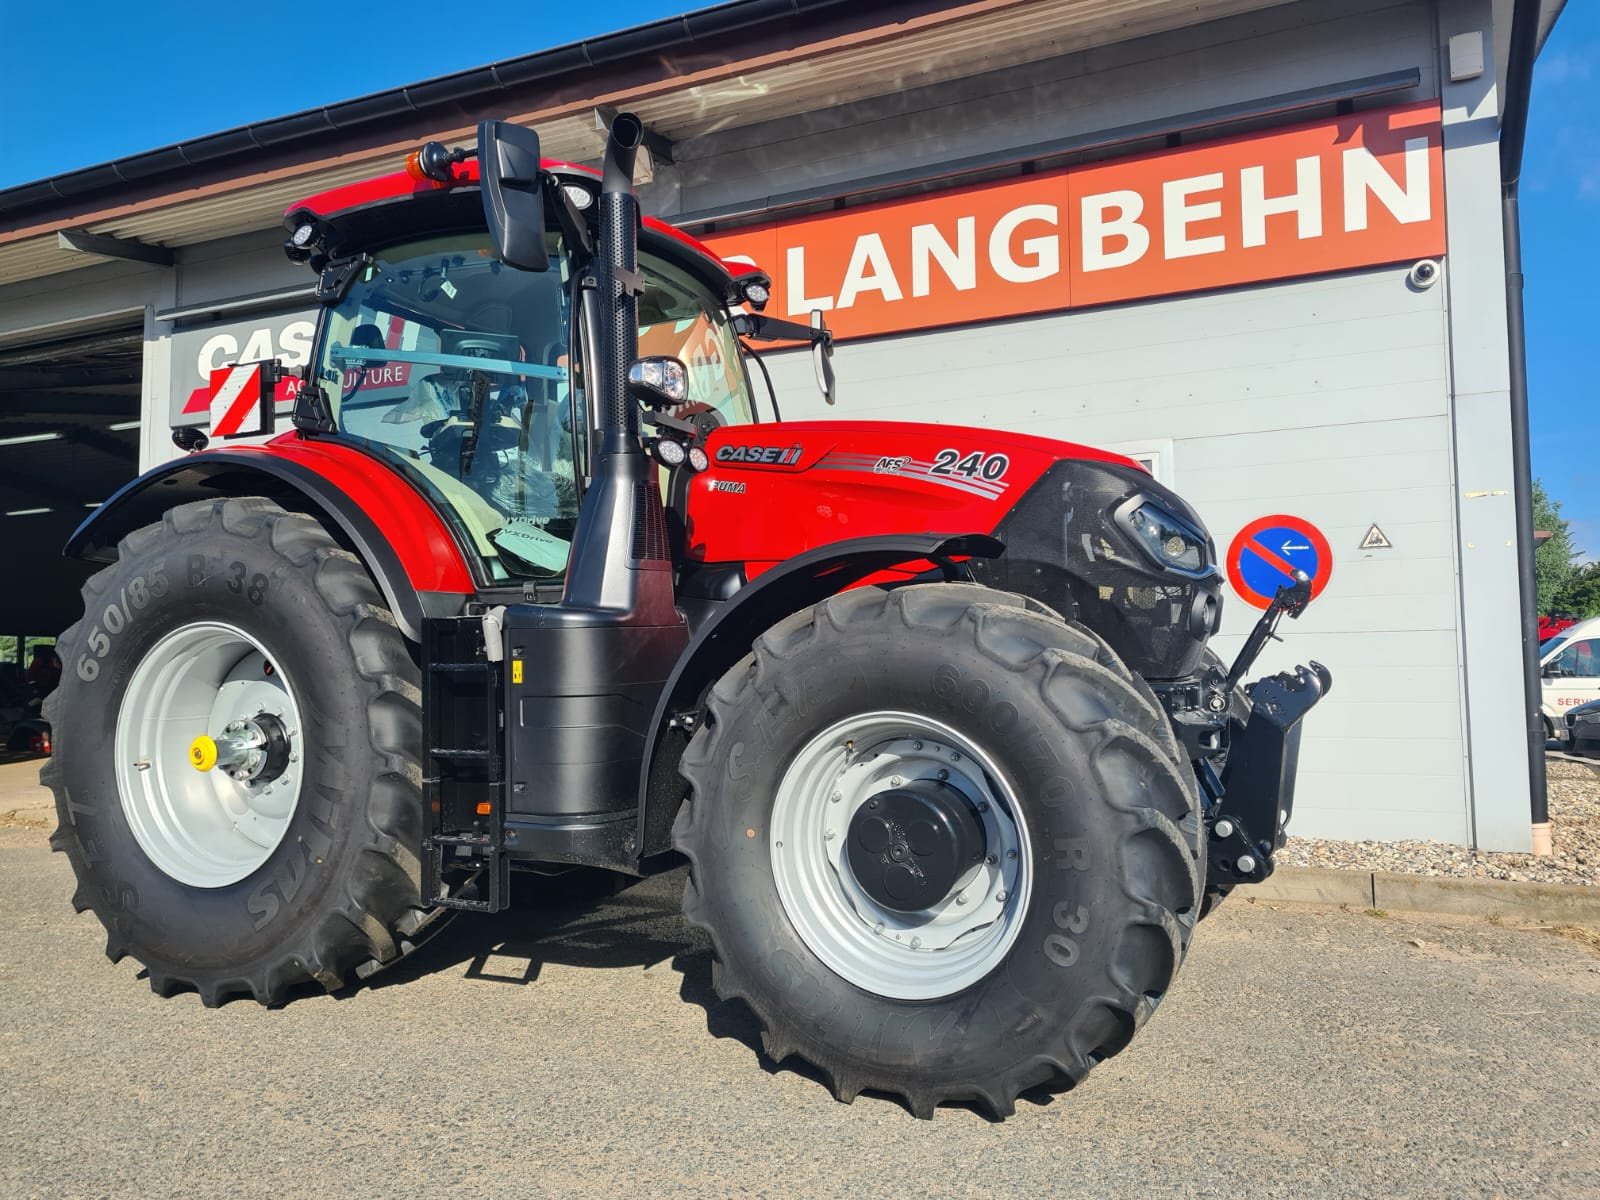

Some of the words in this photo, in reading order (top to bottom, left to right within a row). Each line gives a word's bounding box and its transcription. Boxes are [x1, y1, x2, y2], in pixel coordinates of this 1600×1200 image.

[786, 136, 1432, 317] LANGBEHN
[708, 479, 746, 494] PUMA
[927, 448, 1010, 482] 240
[77, 565, 169, 682] 650/85
[186, 554, 208, 586] R
[225, 560, 270, 606] 38
[1055, 837, 1091, 872] R
[1042, 900, 1090, 967] 30
